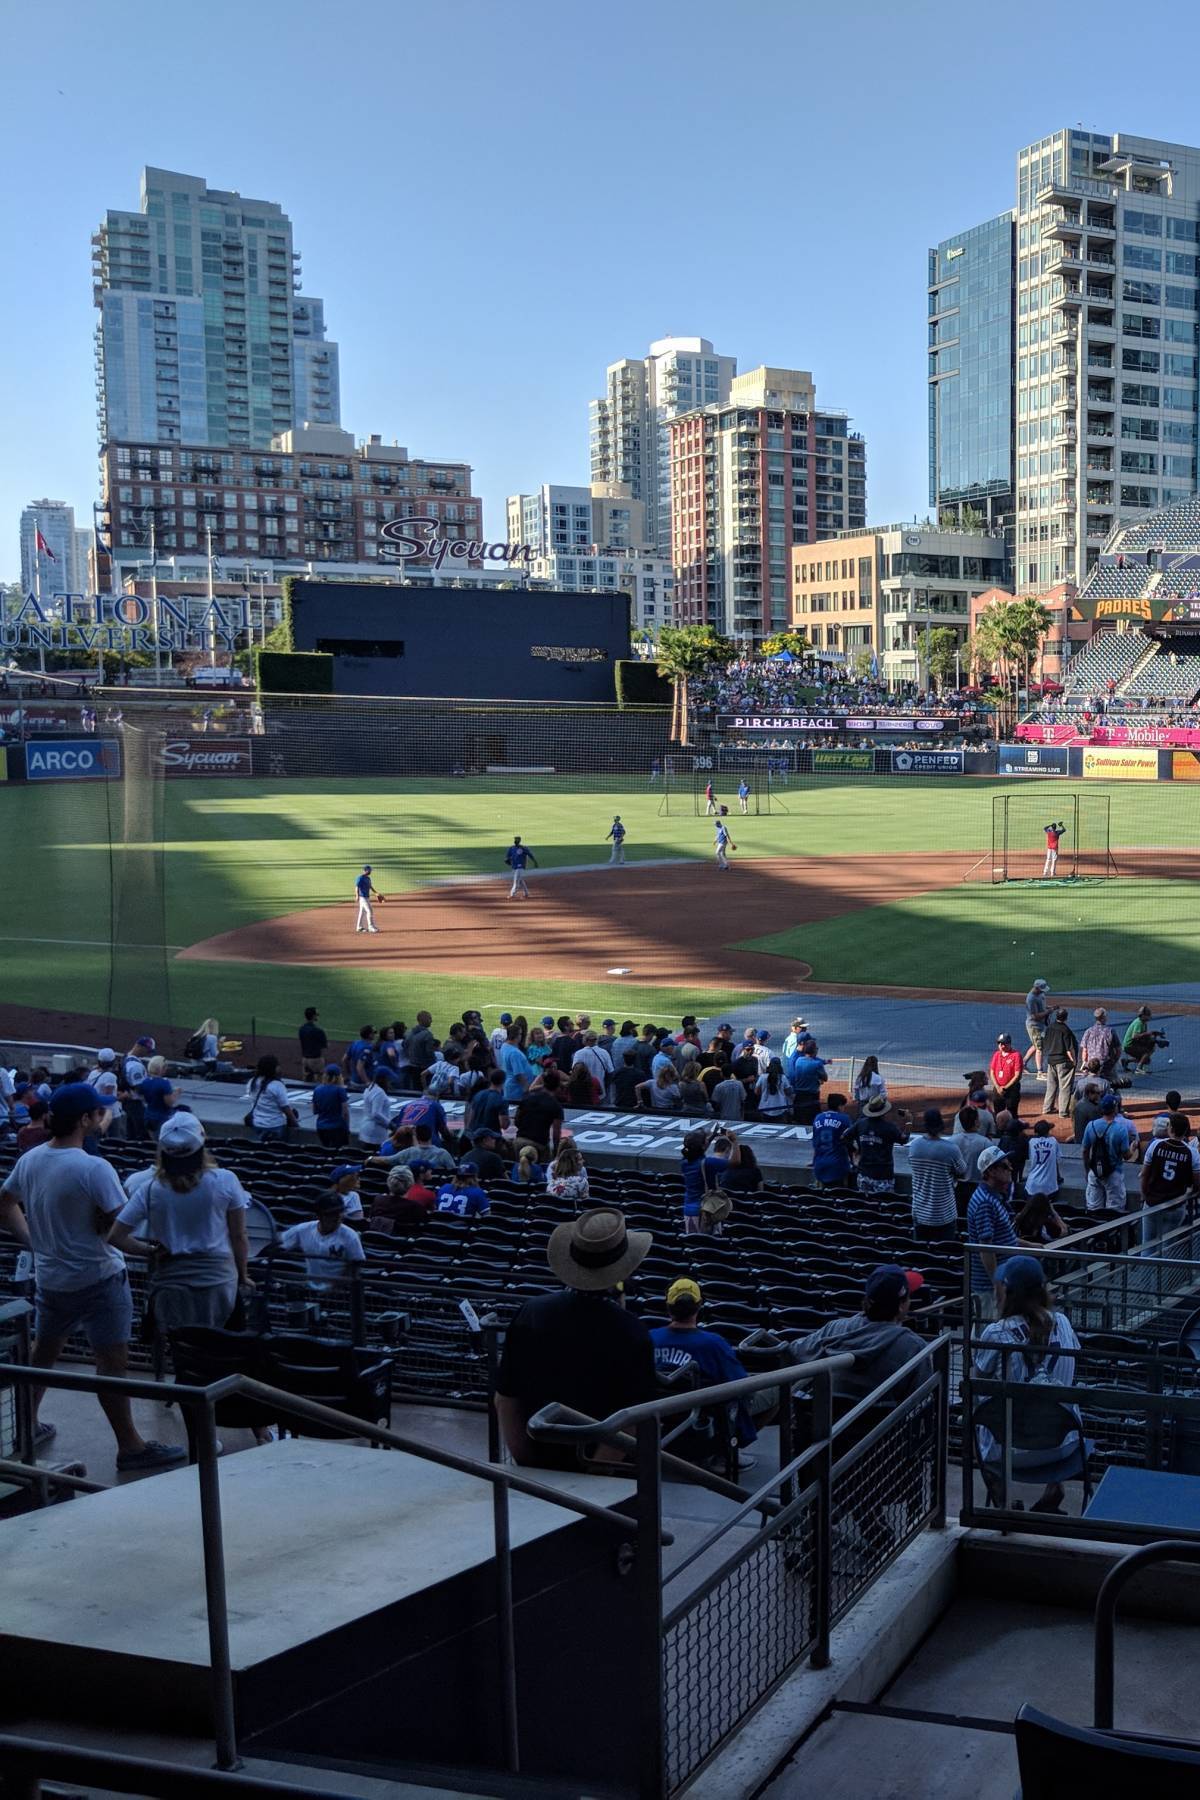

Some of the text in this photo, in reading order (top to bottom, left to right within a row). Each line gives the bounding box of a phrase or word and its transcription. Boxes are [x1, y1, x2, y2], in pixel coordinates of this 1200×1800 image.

[379, 516, 537, 570] Sycuan
[1096, 599, 1152, 619] PADRES
[0, 624, 243, 649] UNIVERSITY
[735, 717, 782, 728] PIRCH
[792, 718, 833, 728] BEACH
[1042, 727, 1055, 743] T
[30, 750, 94, 769] ARCO
[160, 742, 242, 770] Sycuan
[693, 756, 713, 769] 396
[914, 755, 959, 765] PENFED
[1096, 758, 1156, 768] Sullivan Solar Power
[815, 1119, 823, 1129] EL
[1036, 1150, 1051, 1165] 17
[1162, 1160, 1178, 1181] 5
[439, 1193, 468, 1214] 23
[654, 1346, 694, 1367] PRIOR
